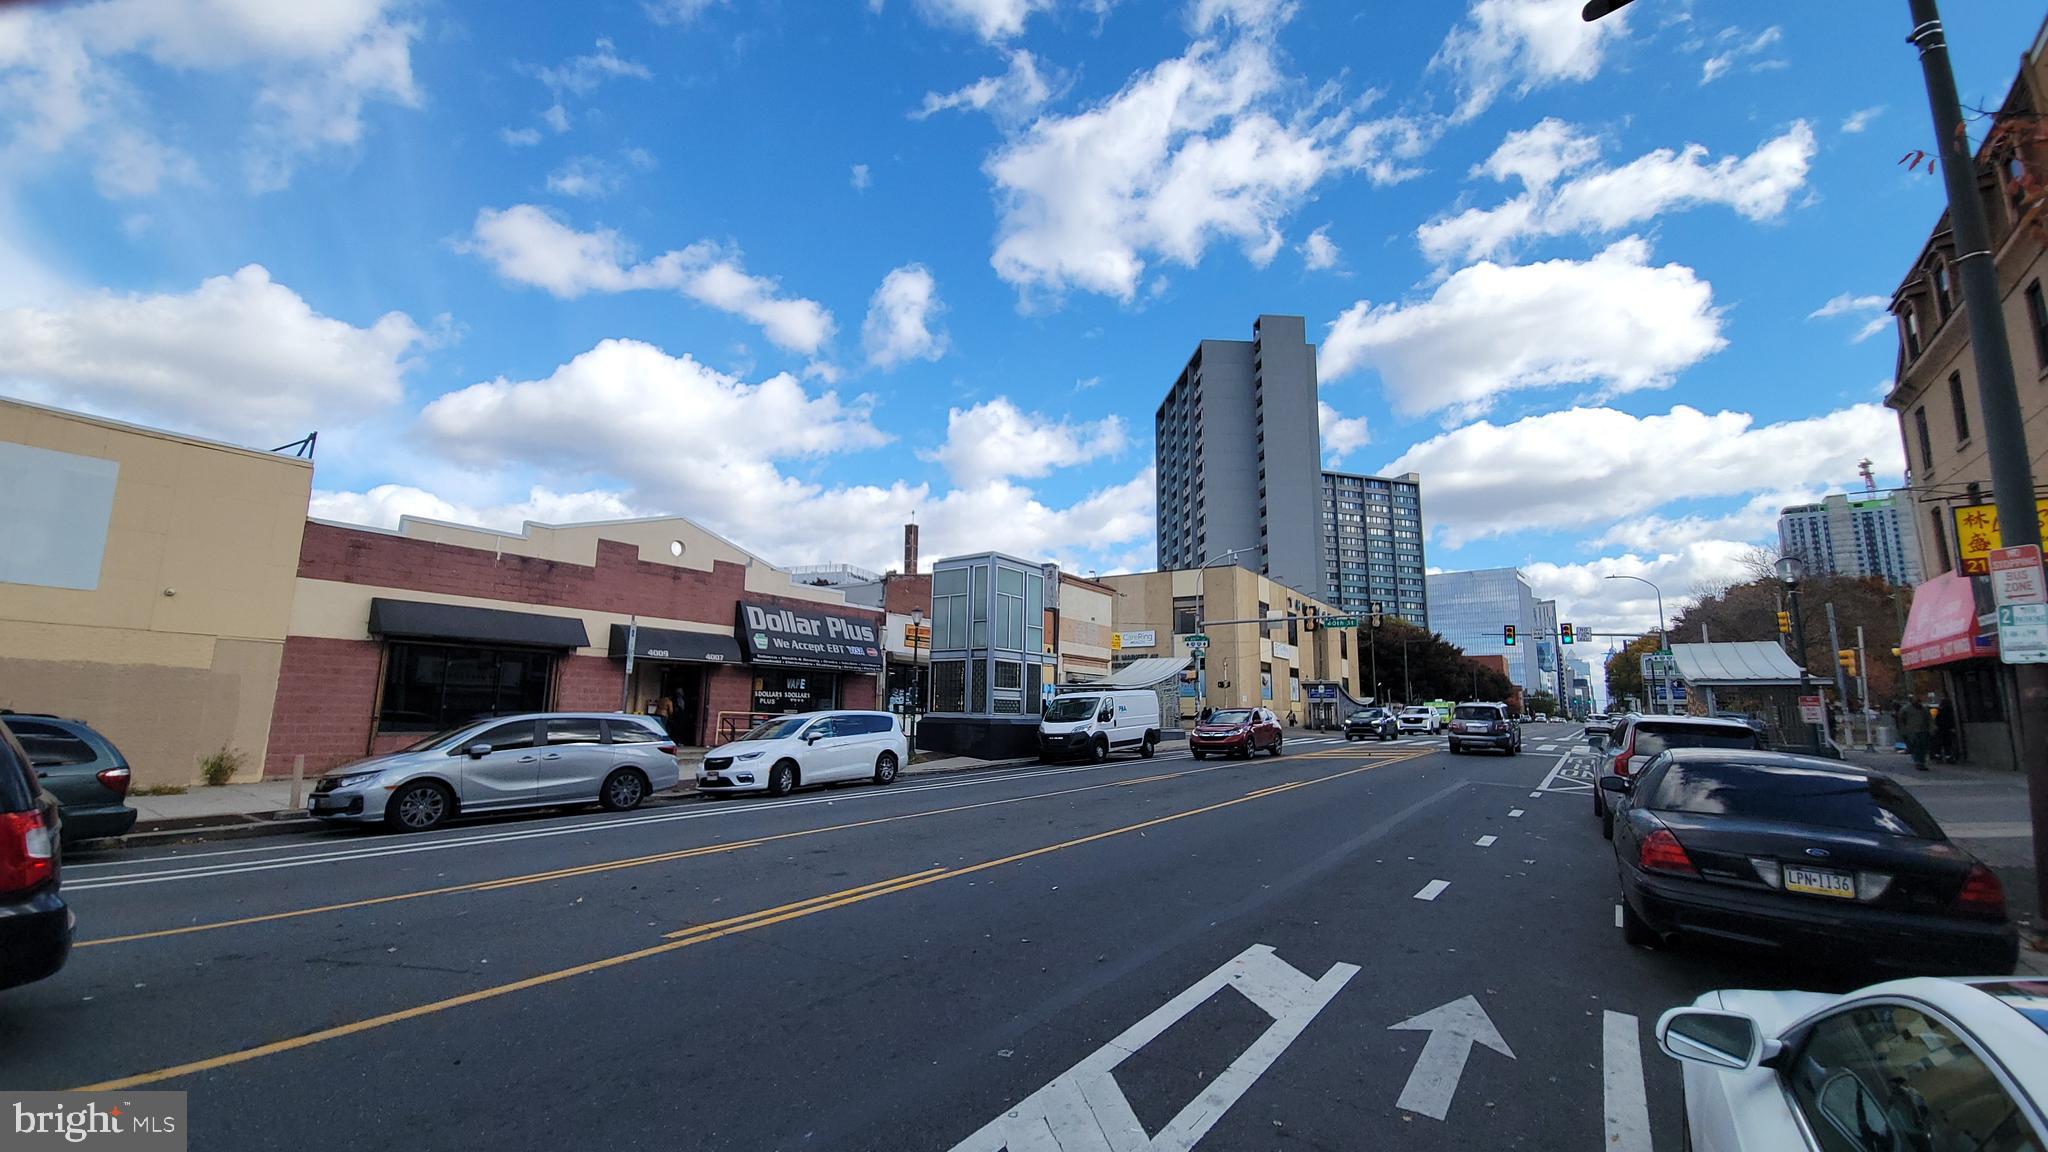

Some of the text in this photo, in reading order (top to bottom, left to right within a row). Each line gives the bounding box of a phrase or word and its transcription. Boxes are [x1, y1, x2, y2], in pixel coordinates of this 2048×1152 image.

[1992, 557, 2039, 569] STOPPING
[2006, 570, 2028, 581] BUS
[2004, 581, 2034, 593] ZONE
[2001, 608, 2011, 624] 2
[746, 605, 821, 637] Dollar
[825, 616, 875, 642] Plus
[773, 638, 845, 654] We Accept EBT
[647, 649, 669, 657] 4009
[705, 653, 724, 661] 4007
[786, 678, 806, 690] VAPE
